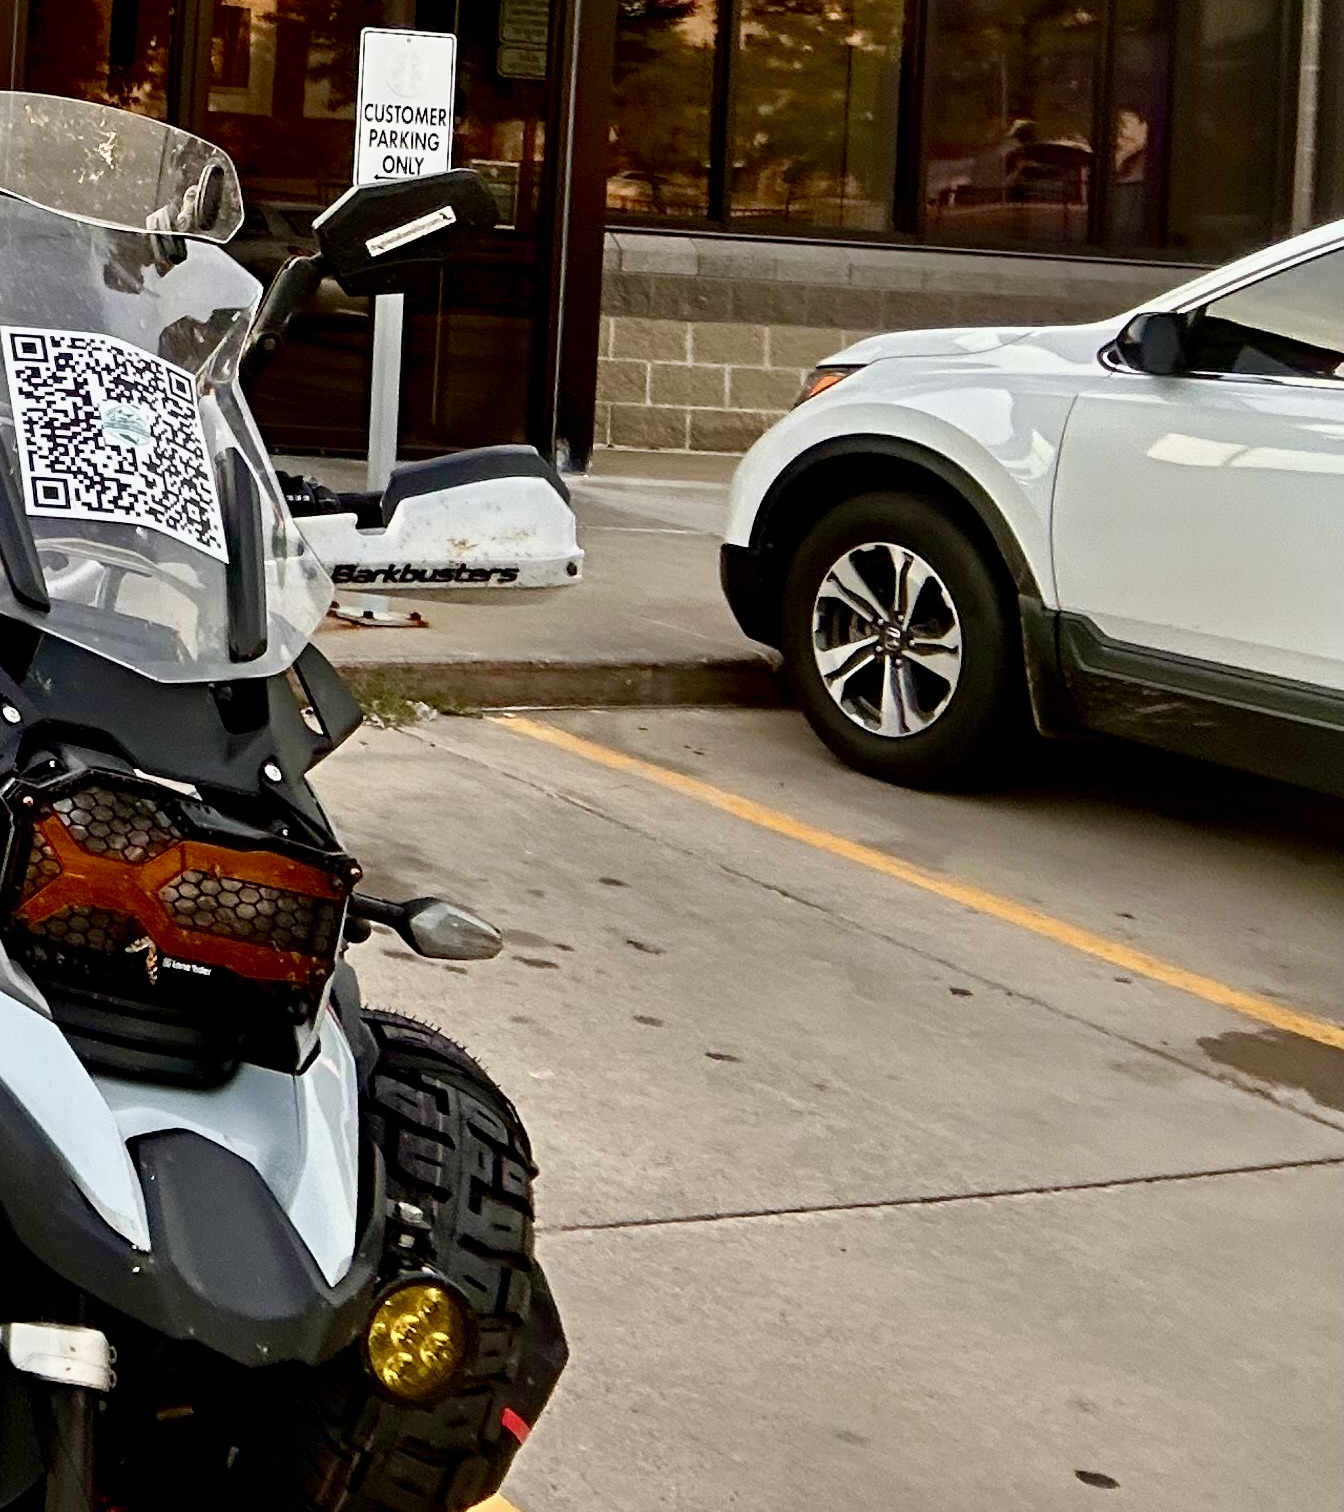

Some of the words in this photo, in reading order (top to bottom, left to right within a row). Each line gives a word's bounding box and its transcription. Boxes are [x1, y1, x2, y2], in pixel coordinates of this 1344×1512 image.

[364, 103, 447, 127] CUSTOMER
[368, 128, 440, 152] PARKING
[382, 155, 425, 176] ONLY
[331, 562, 520, 584] Barkbusters
